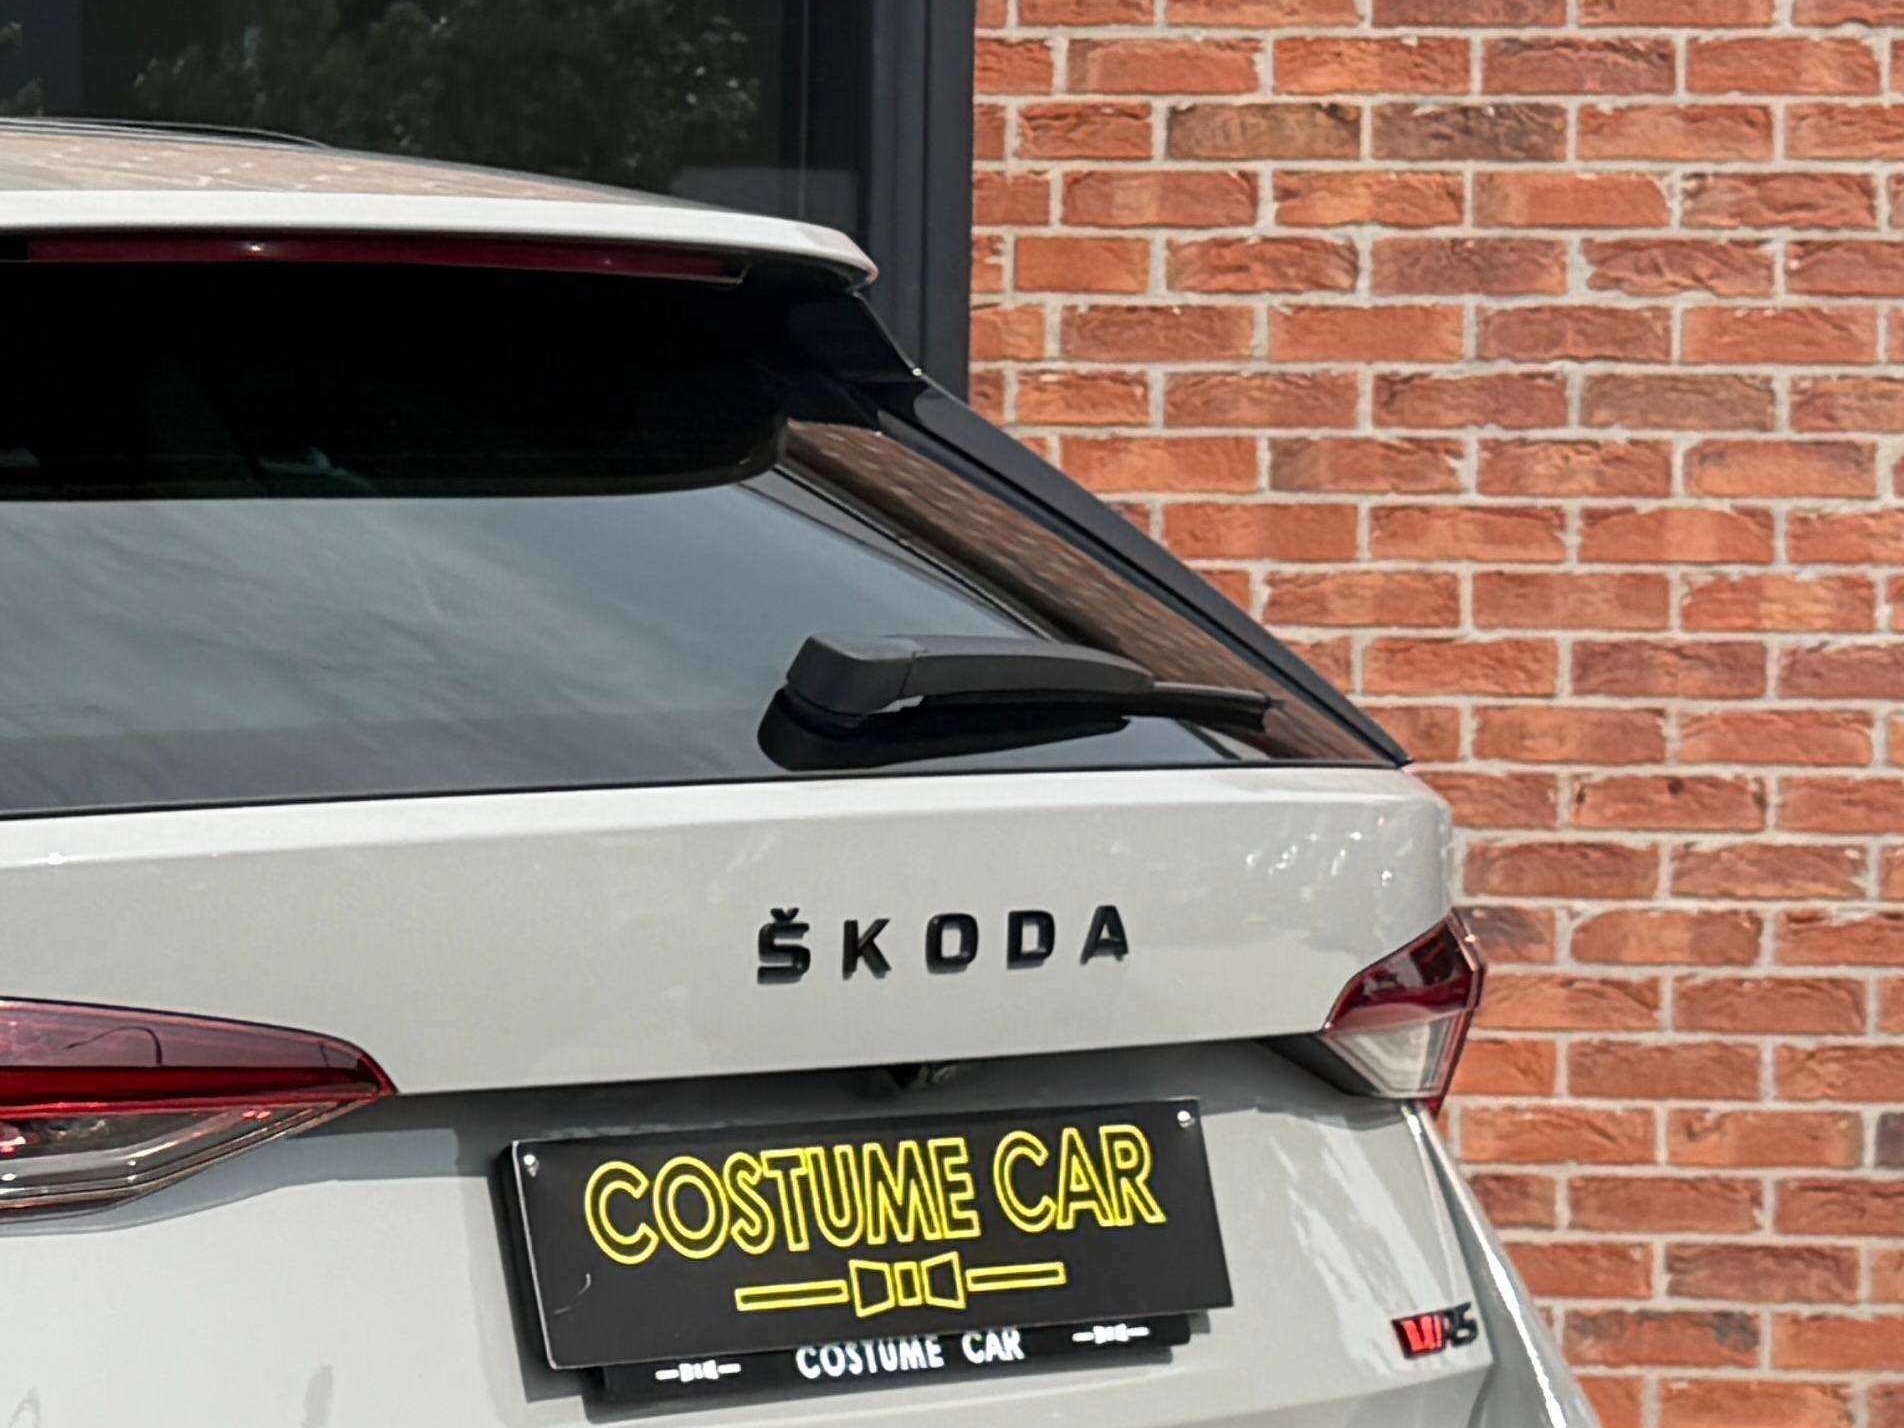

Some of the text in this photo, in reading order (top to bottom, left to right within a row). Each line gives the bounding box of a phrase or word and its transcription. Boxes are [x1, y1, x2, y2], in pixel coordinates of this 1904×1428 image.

[757, 904, 1130, 985] ŠKODA
[584, 1124, 1167, 1264] COSTUME CAR
[795, 1328, 1025, 1380] COSTUME CAR
